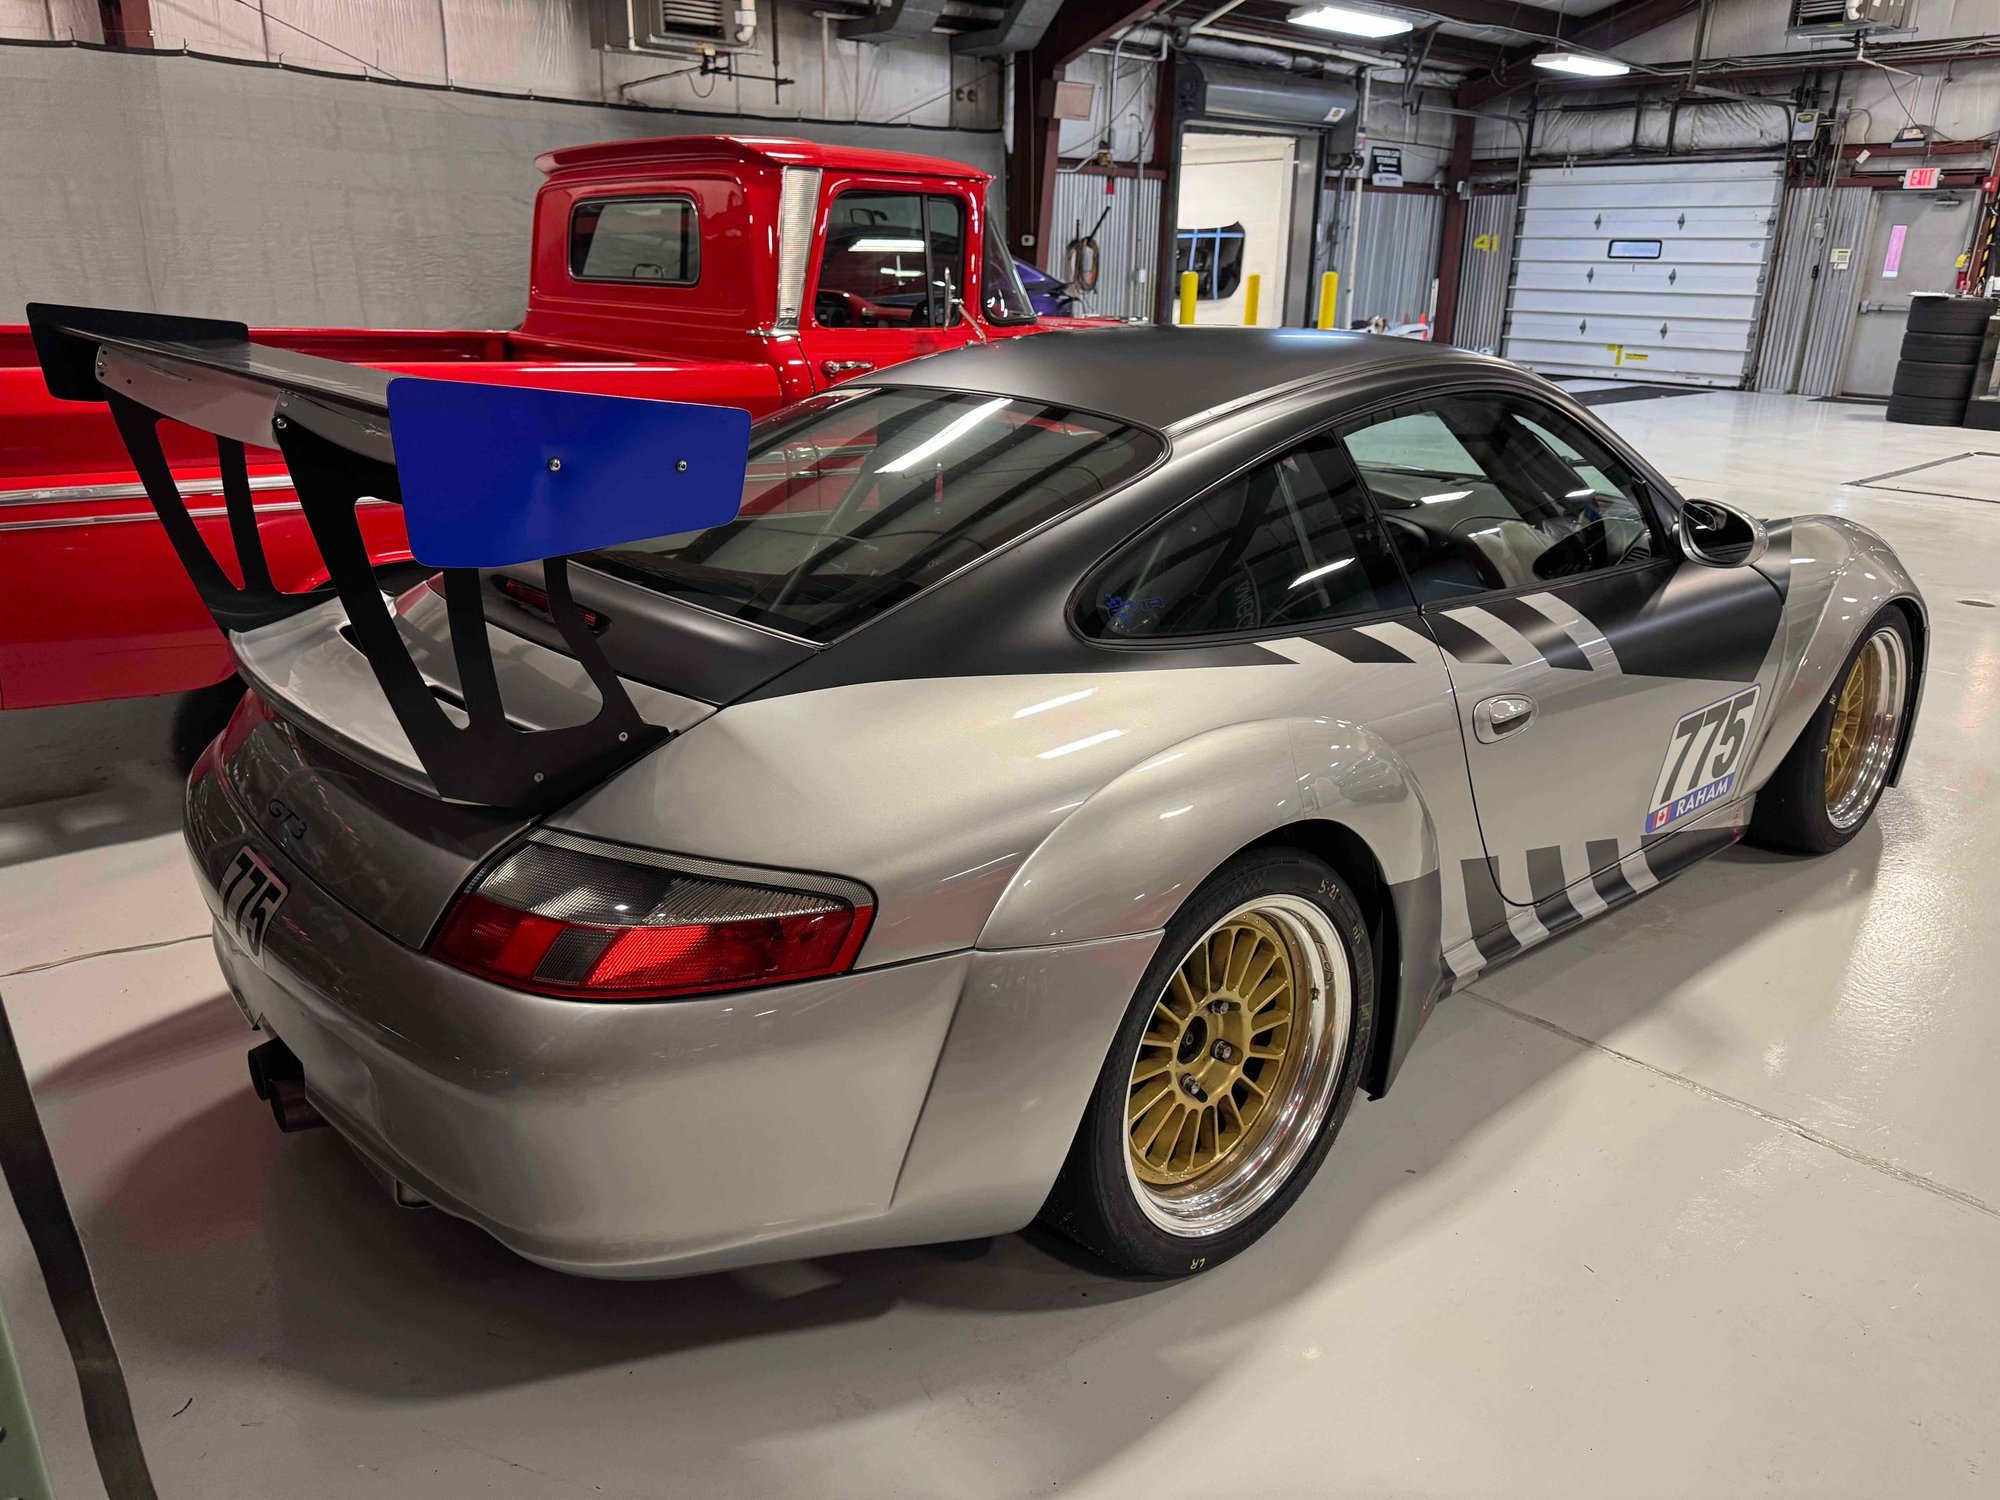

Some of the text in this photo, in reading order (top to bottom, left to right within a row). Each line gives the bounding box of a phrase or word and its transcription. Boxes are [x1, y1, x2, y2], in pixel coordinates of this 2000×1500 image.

[1909, 169, 1935, 187] EXIT
[1473, 233, 1499, 253] 41
[1660, 689, 1757, 805] 775
[1675, 778, 1728, 817] RAHAM
[268, 799, 308, 839] GT3
[222, 851, 282, 957] 775
